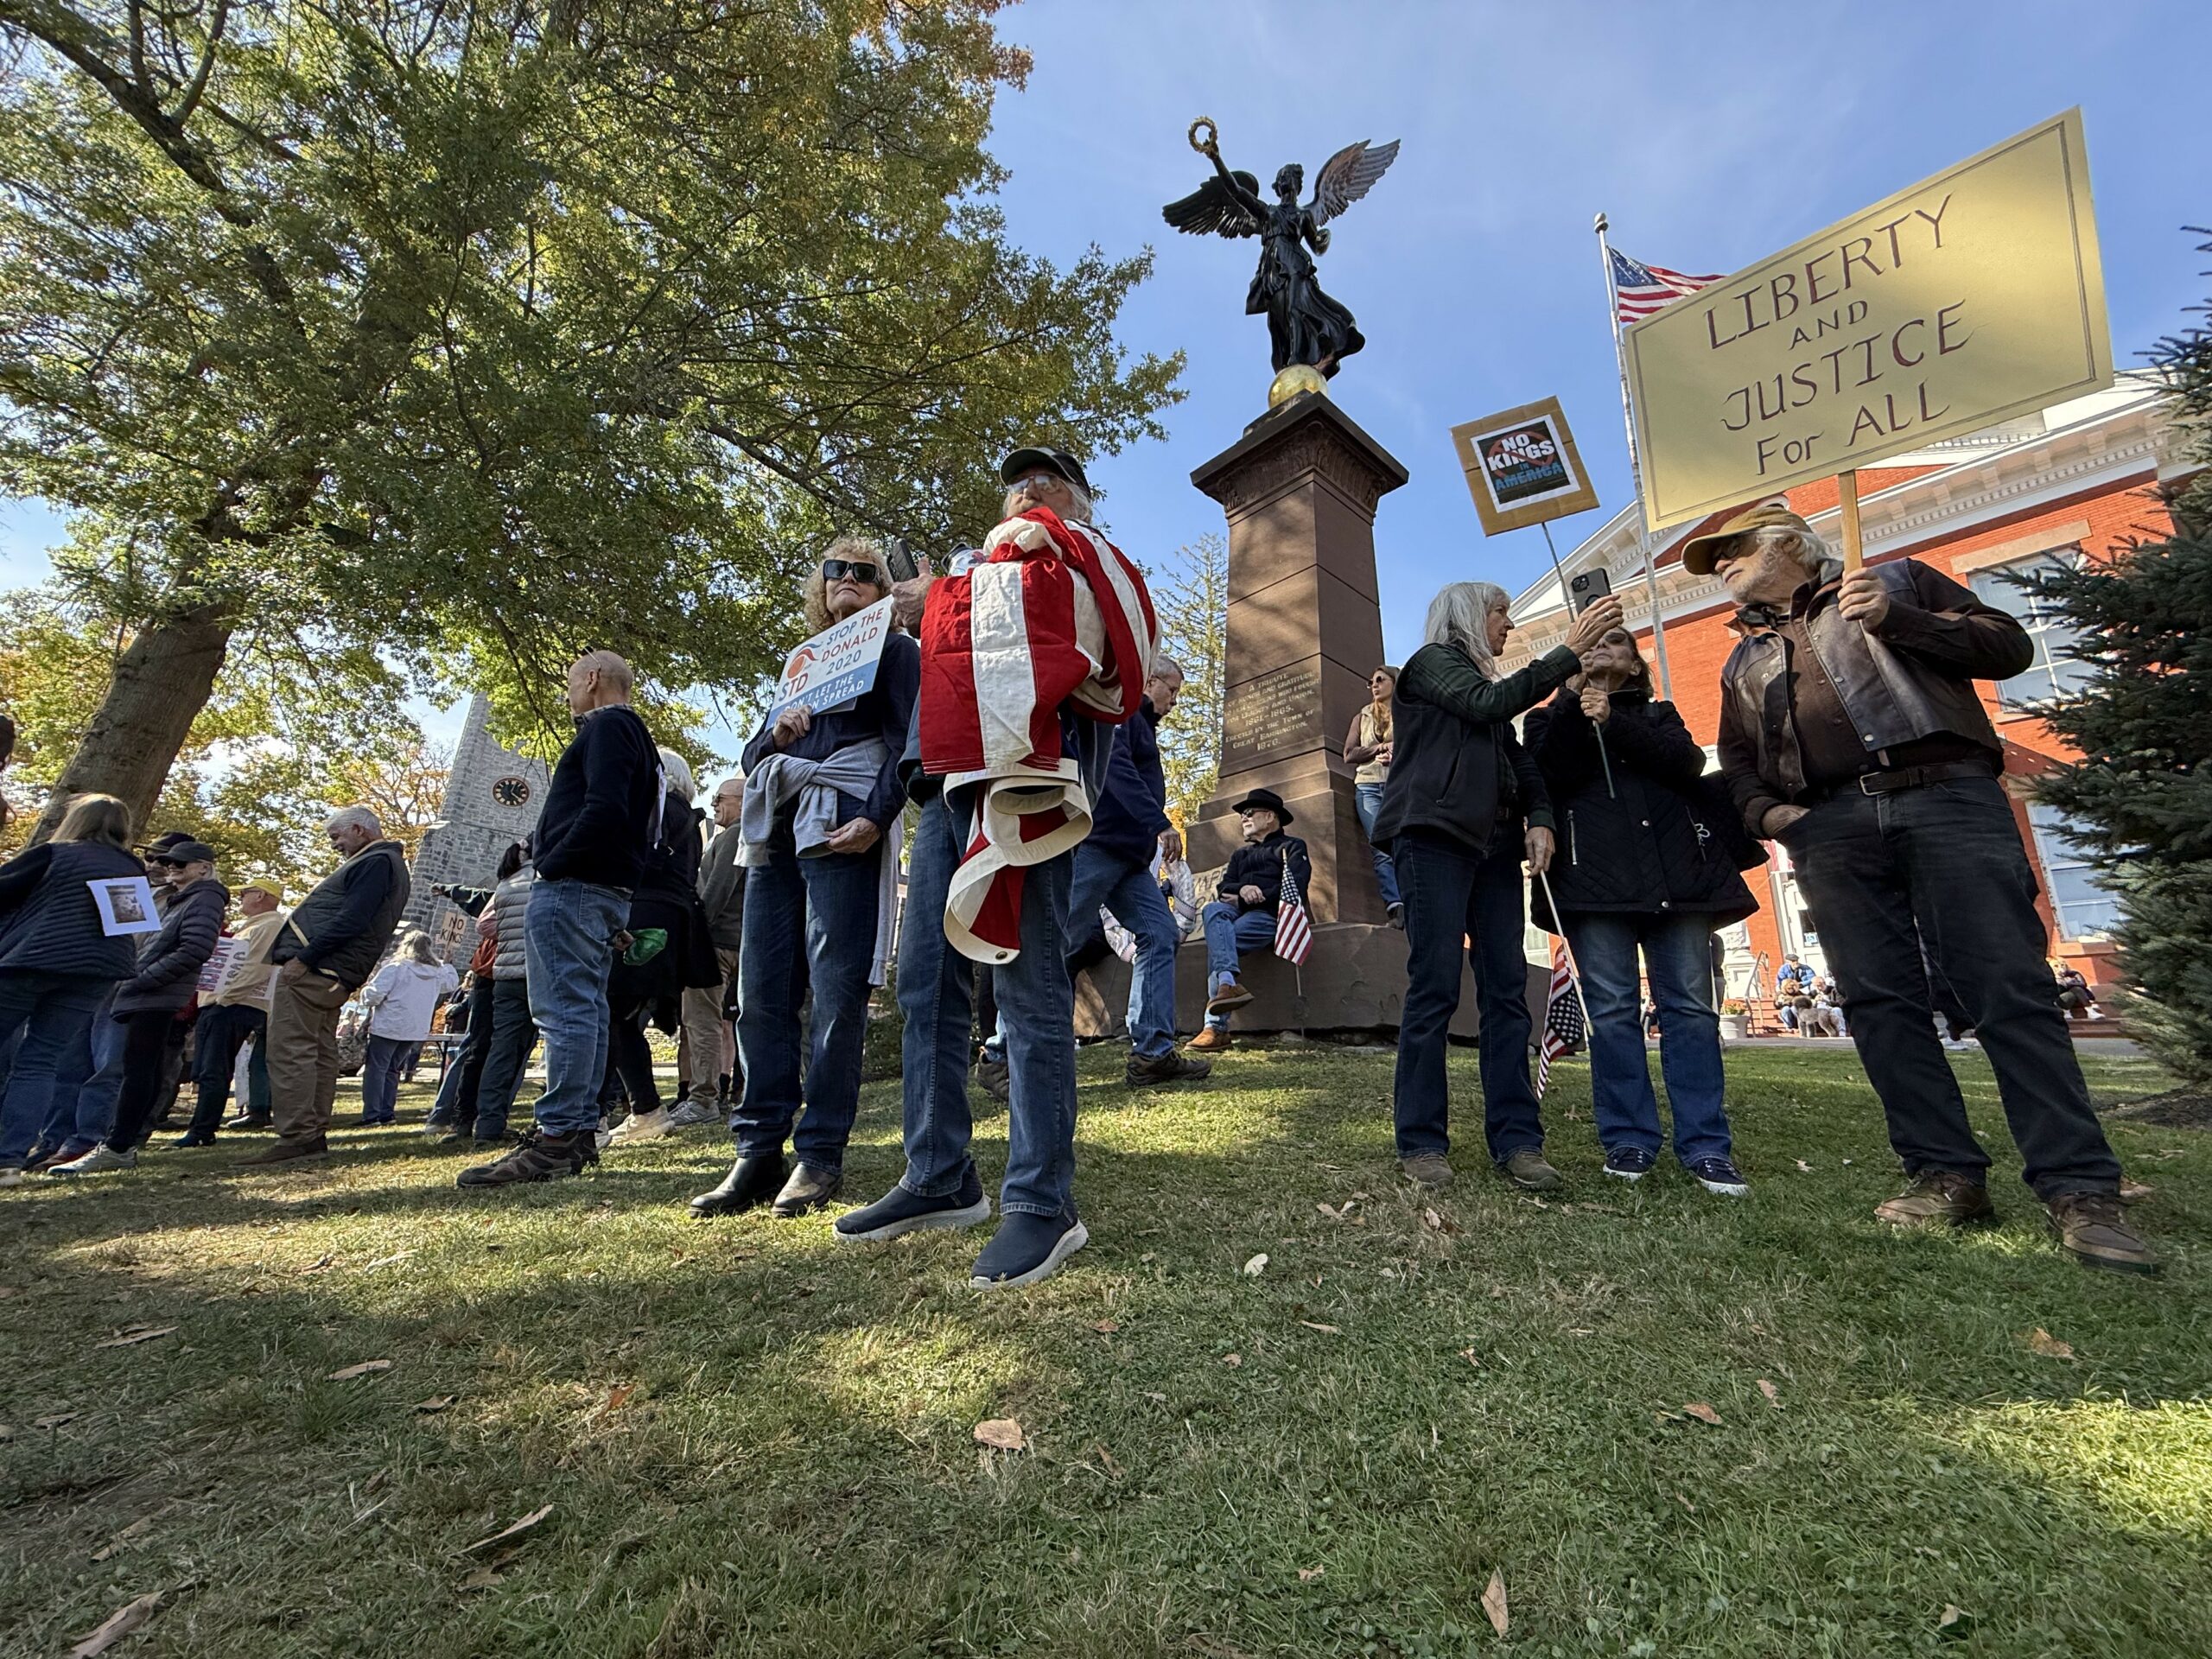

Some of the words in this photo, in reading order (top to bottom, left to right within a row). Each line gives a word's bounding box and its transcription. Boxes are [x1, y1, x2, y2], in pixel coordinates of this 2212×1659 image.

[1702, 192, 1953, 351] LIBERTY
[1788, 300, 1868, 351] AND
[1719, 299, 1976, 432] JUSTICE
[1844, 377, 1950, 447] ALL
[1487, 440, 1555, 471] KINGS
[1502, 434, 1529, 452] NO
[1494, 461, 1564, 491] AMERICA
[826, 620, 858, 646] STOP
[861, 607, 885, 628] THE
[821, 626, 878, 663] DONALD
[826, 649, 862, 676] 2020
[779, 672, 809, 702] STD
[815, 683, 830, 698] LET
[835, 674, 855, 690] THE
[822, 680, 864, 706] SPREAD
[1262, 686, 1276, 696] AND
[1271, 699, 1286, 709] AND
[1267, 721, 1279, 729] THE
[1282, 713, 1303, 724] TOWN
[448, 917, 465, 931] NO
